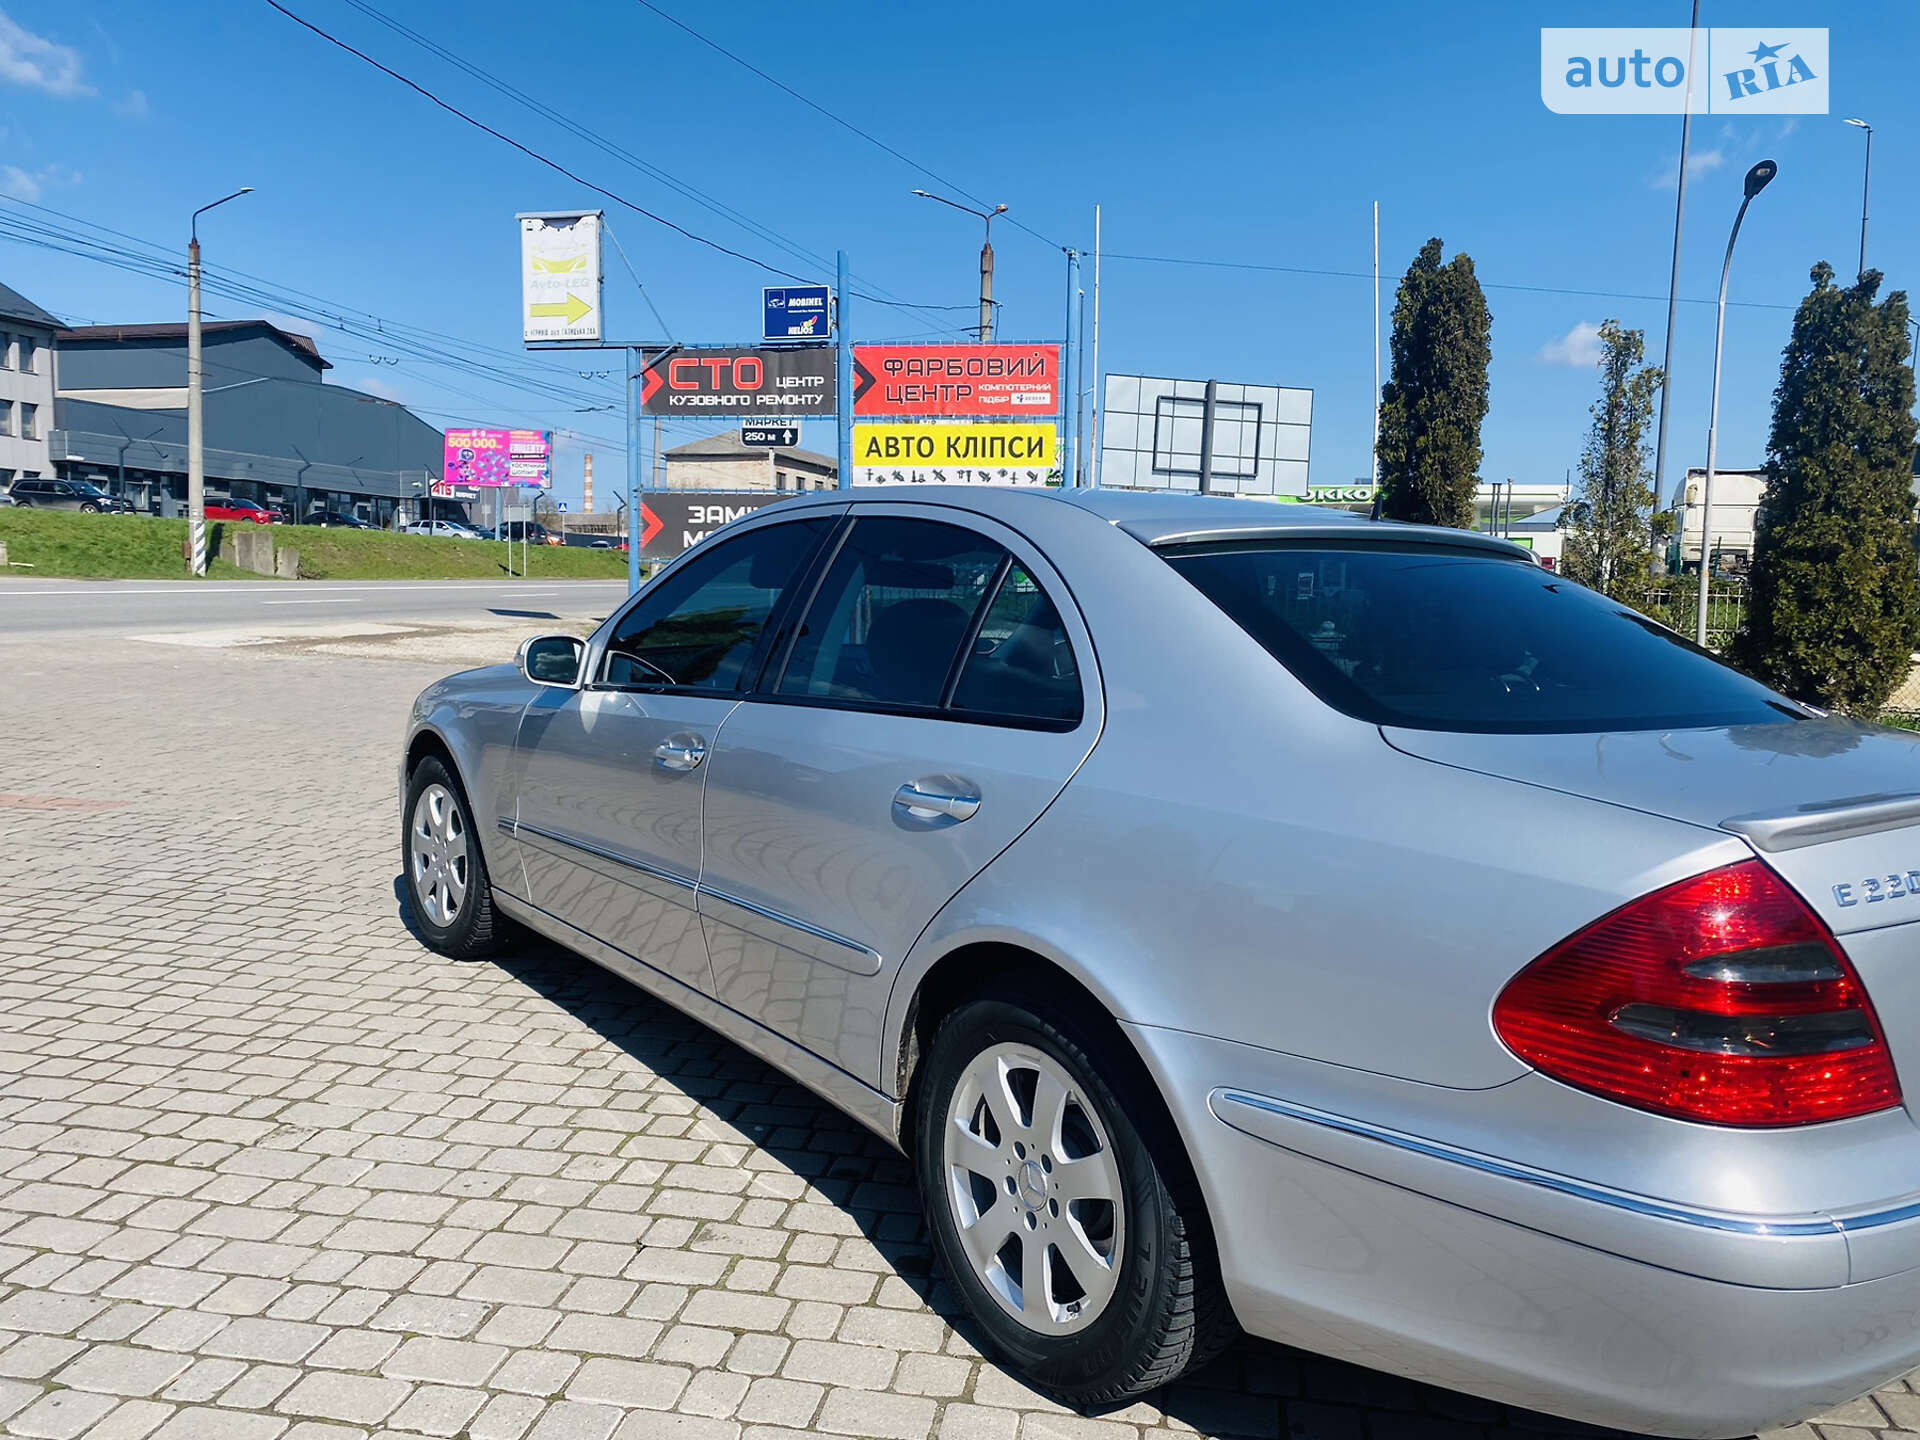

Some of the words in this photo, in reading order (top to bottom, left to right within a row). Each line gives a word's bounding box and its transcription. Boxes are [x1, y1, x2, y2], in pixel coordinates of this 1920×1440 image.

[787, 325, 814, 335] HELIOS
[668, 356, 764, 391] СТО
[775, 376, 825, 388] ЦЕНТР
[883, 352, 1046, 377] ФАРБОВИЙ
[669, 395, 751, 406] КУЗОВНОГО
[756, 394, 824, 405] РЕМОНТУ
[885, 384, 973, 405] ЦЕНТР
[448, 438, 471, 448] 500
[473, 439, 497, 448] 000
[744, 432, 766, 441] 250
[865, 436, 934, 459] АВТО
[946, 436, 1044, 459] КЛІПСИ
[1831, 883, 1858, 908] E
